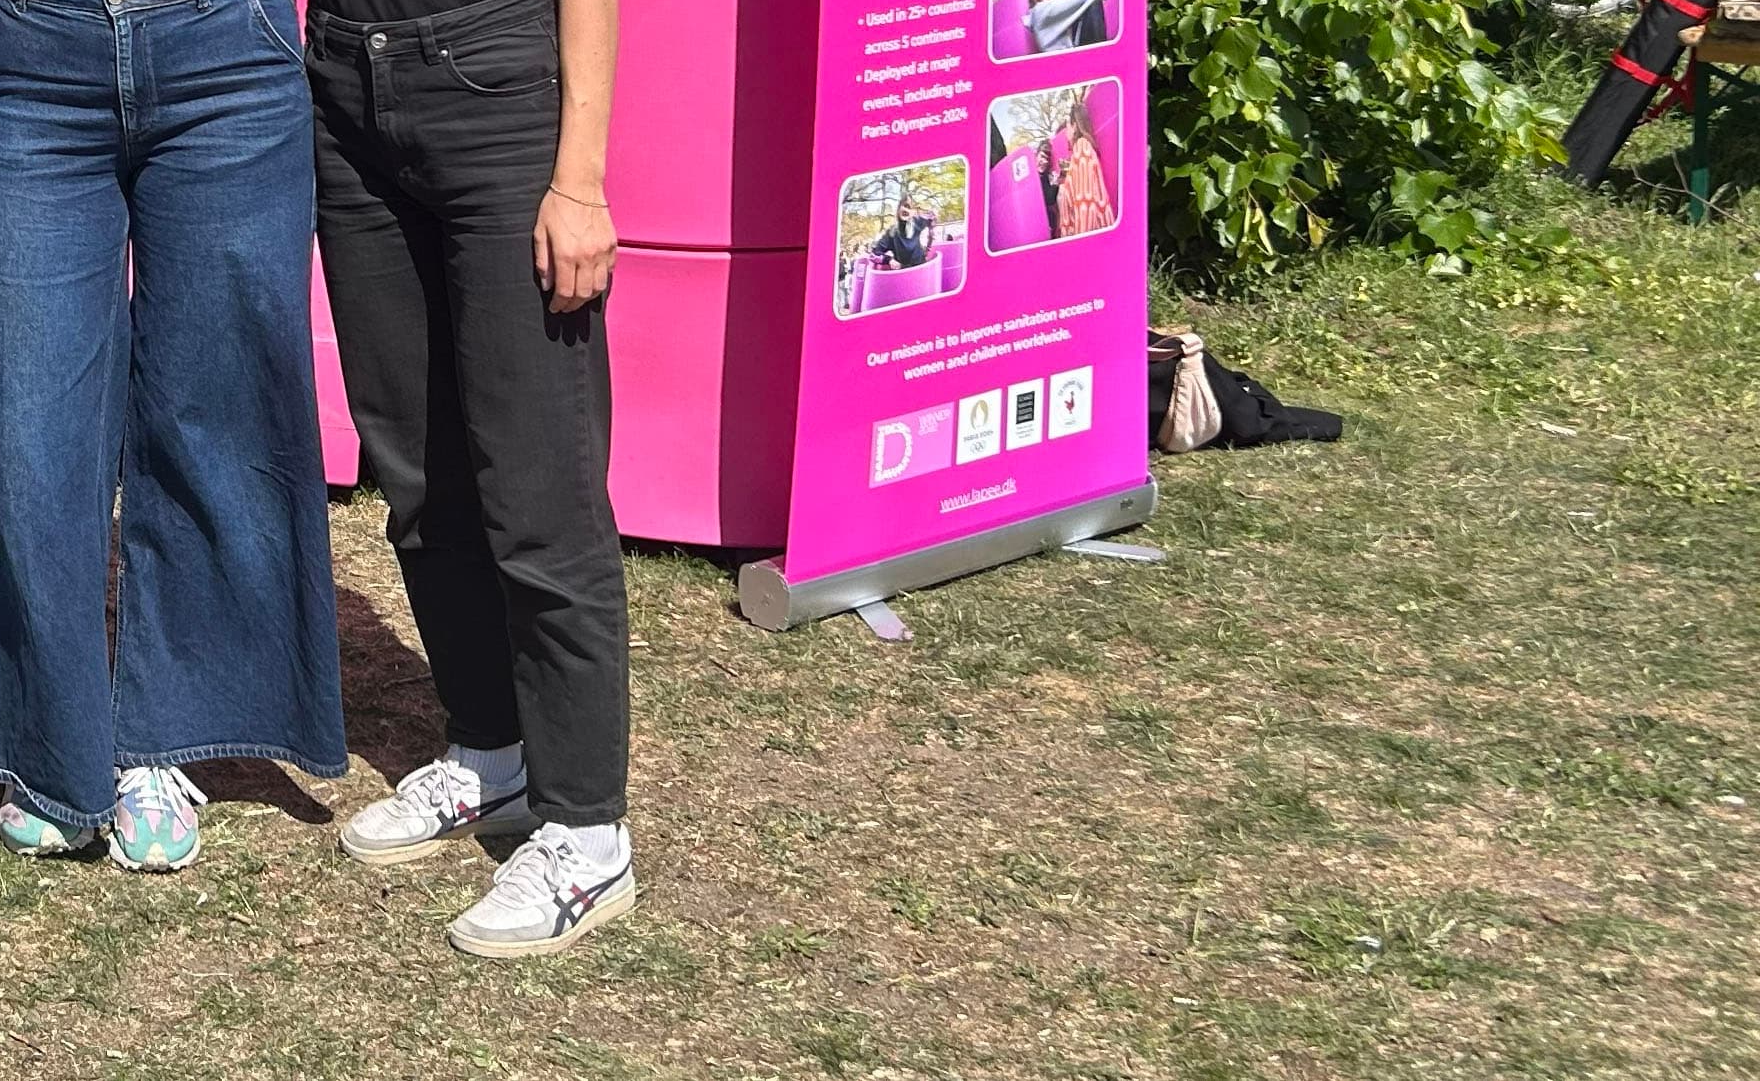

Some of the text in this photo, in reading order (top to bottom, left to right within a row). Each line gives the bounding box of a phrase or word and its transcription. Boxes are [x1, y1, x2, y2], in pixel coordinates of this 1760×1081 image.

[865, 8, 895, 27] Used
[895, 7, 907, 22] in
[908, 4, 927, 20] 25+
[864, 27, 966, 55] across 5 continents
[864, 54, 961, 83] Deployed at major
[863, 80, 972, 111] events, including the
[861, 106, 968, 139] Paris Olympics 2024
[866, 298, 1105, 367] Our mission is to improve sanitation access to
[903, 327, 1072, 381] women and children worldwide.
[940, 476, 1017, 513] www.lapee.dk
